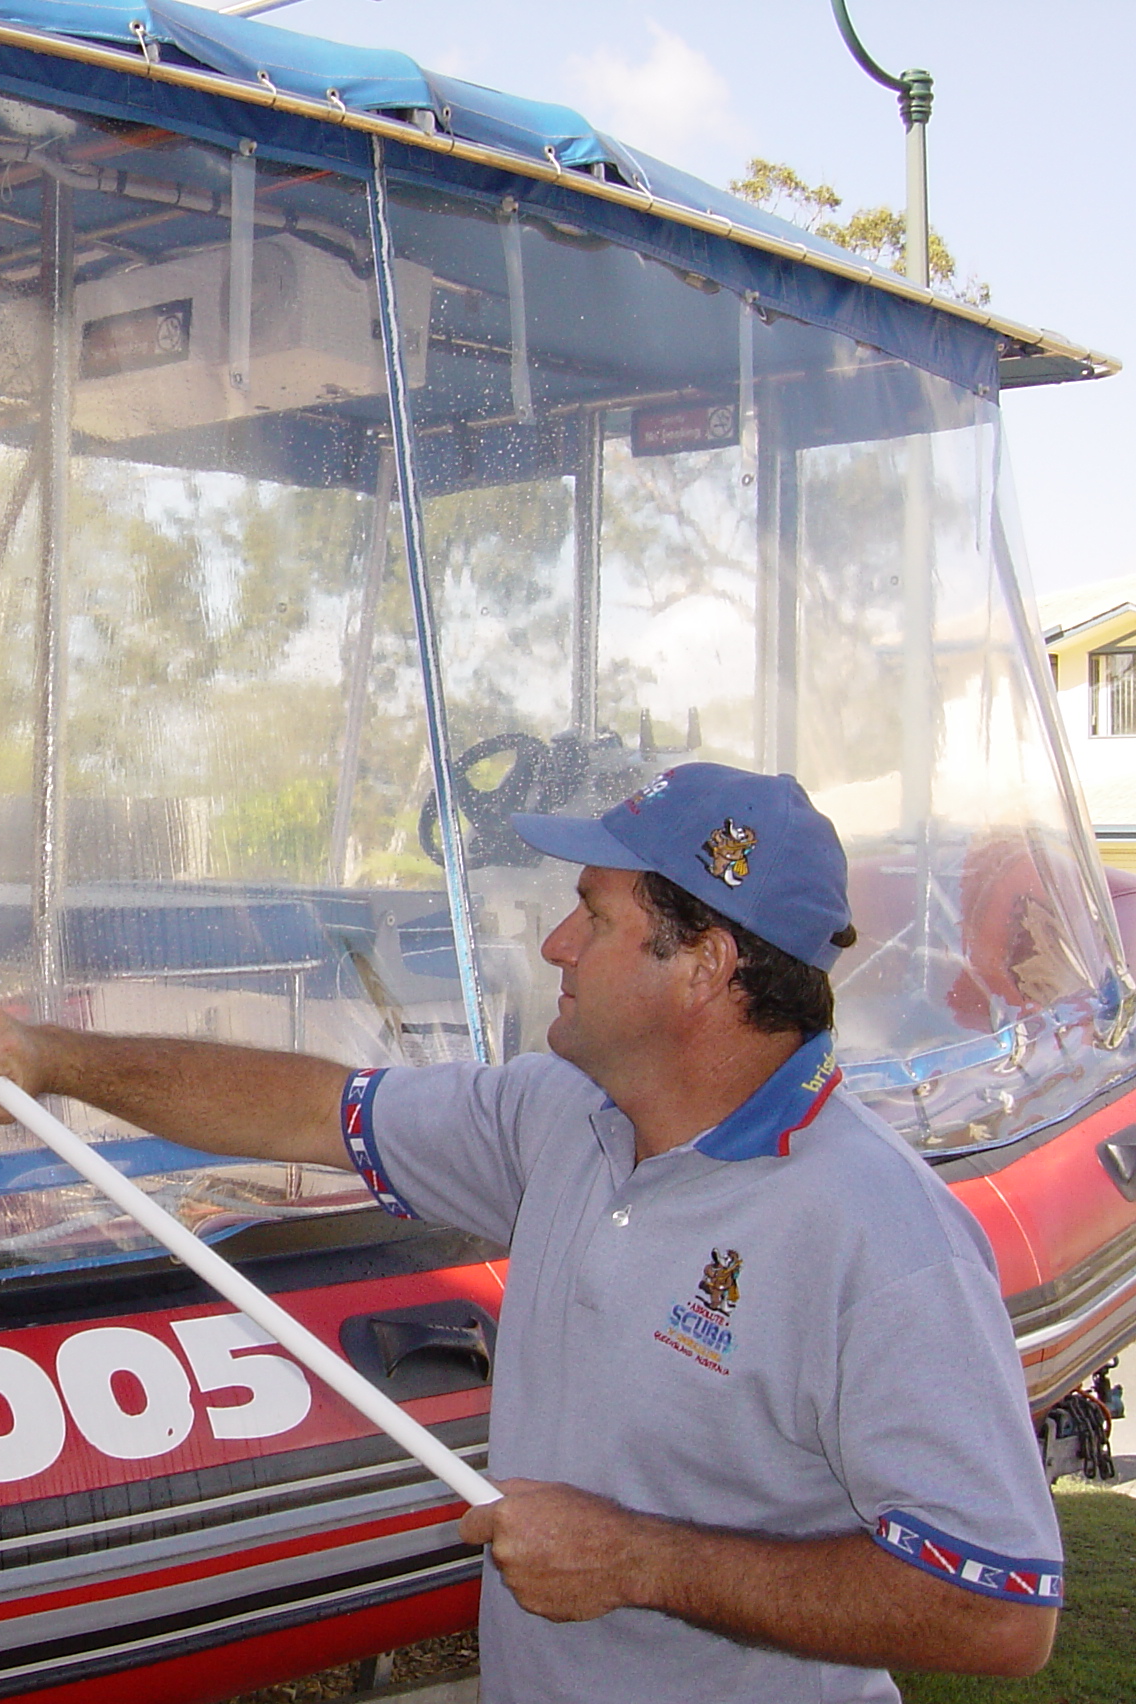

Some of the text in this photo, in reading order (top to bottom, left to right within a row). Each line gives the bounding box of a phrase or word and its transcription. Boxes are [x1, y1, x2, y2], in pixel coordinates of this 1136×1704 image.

[690, 1304, 725, 1325] ABSOLUTE
[670, 1304, 732, 1352] SCUBA
[695, 1355, 730, 1375] AUSTRALIA
